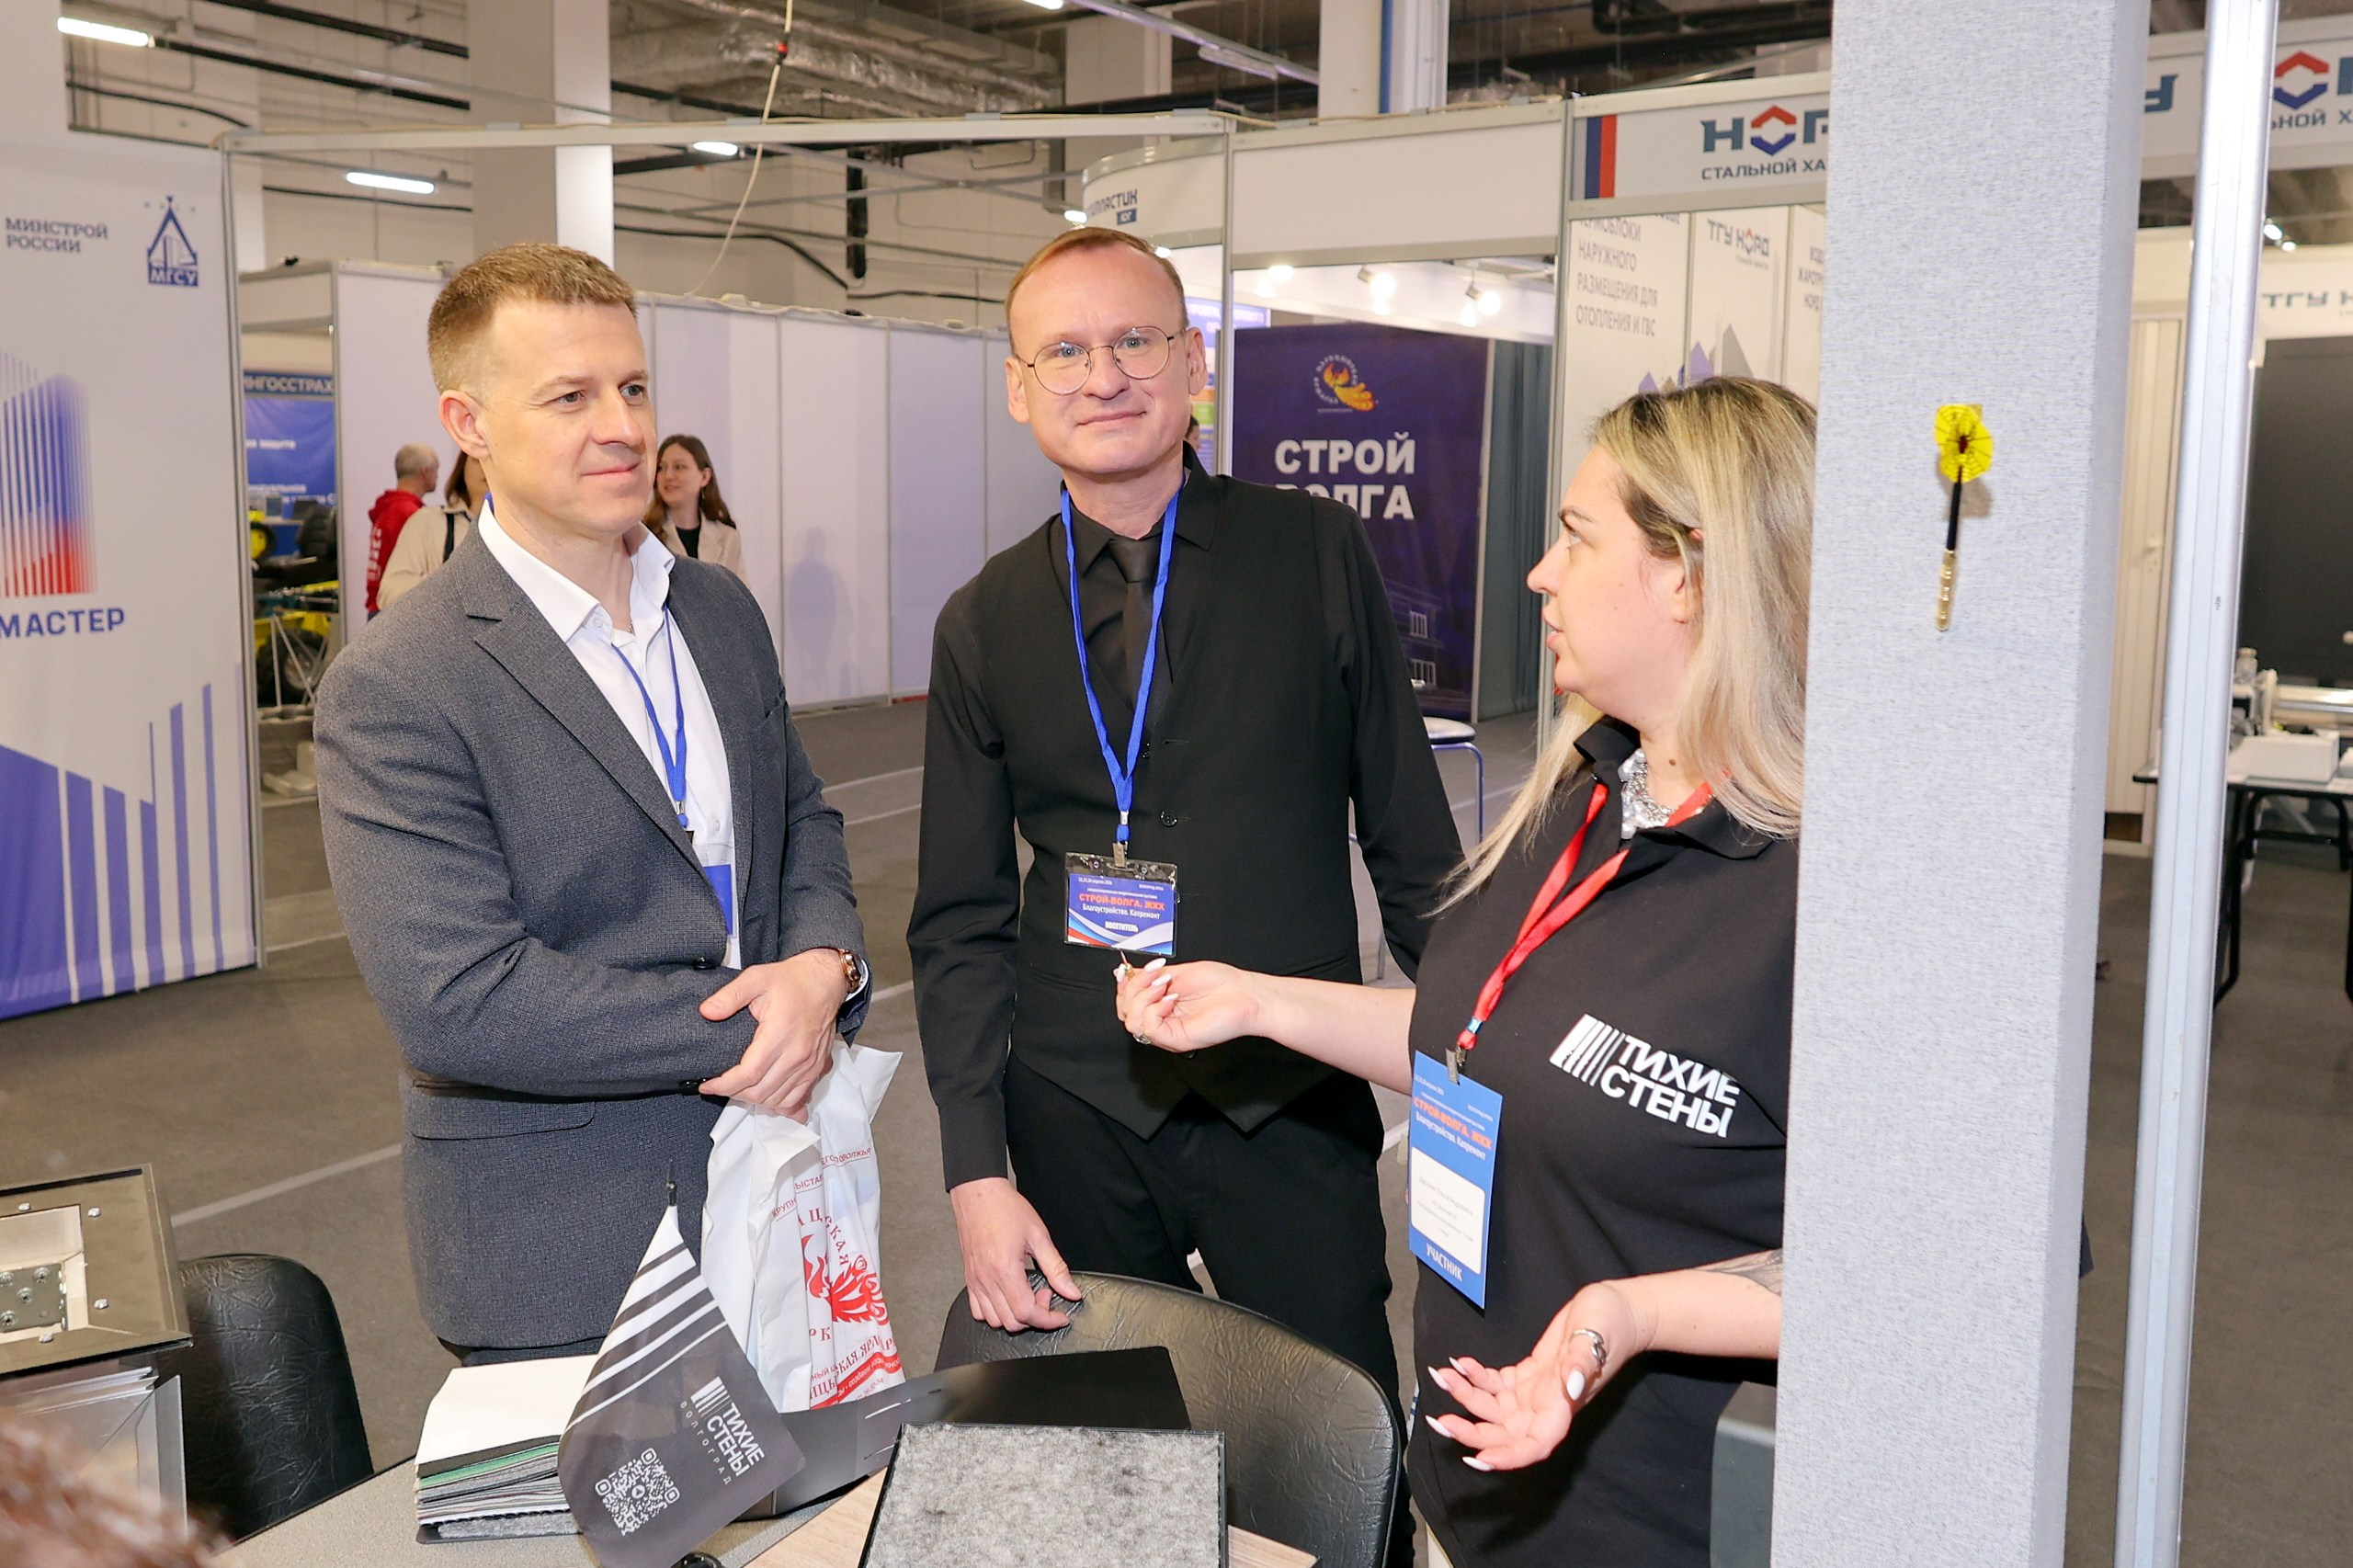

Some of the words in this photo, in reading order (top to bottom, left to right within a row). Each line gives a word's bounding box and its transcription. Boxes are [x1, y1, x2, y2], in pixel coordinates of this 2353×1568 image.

[1701, 158, 1797, 180] СТАЛЬНОЙ
[1802, 159, 1826, 173] ХА
[6, 217, 108, 239] МИНСТРОЙ
[6, 235, 81, 253] РОССИИ
[1707, 218, 1733, 246] ТГУ
[1578, 239, 1637, 272] НАРУЖНОГО
[1577, 272, 1639, 302] РАЗМЕЩЕНИЯ
[2262, 290, 2328, 309] ТГУ
[1576, 304, 1631, 332] ОТОПЛЕНИЯ
[1275, 431, 1416, 475] СТРОЙ
[1276, 483, 1415, 520] ЛГА
[0, 608, 125, 639] МАСТЕР
[1618, 1032, 1742, 1107] ТИХИЕ
[1599, 1066, 1735, 1139] СТЕНЫ
[772, 1198, 797, 1218] КРУПН
[1427, 1243, 1463, 1282] УЧАСТНИК
[680, 1400, 732, 1485] ВОЛГОГРАД
[707, 1415, 750, 1477] СТЕНЫ
[722, 1402, 766, 1466] ТИХИЕ
